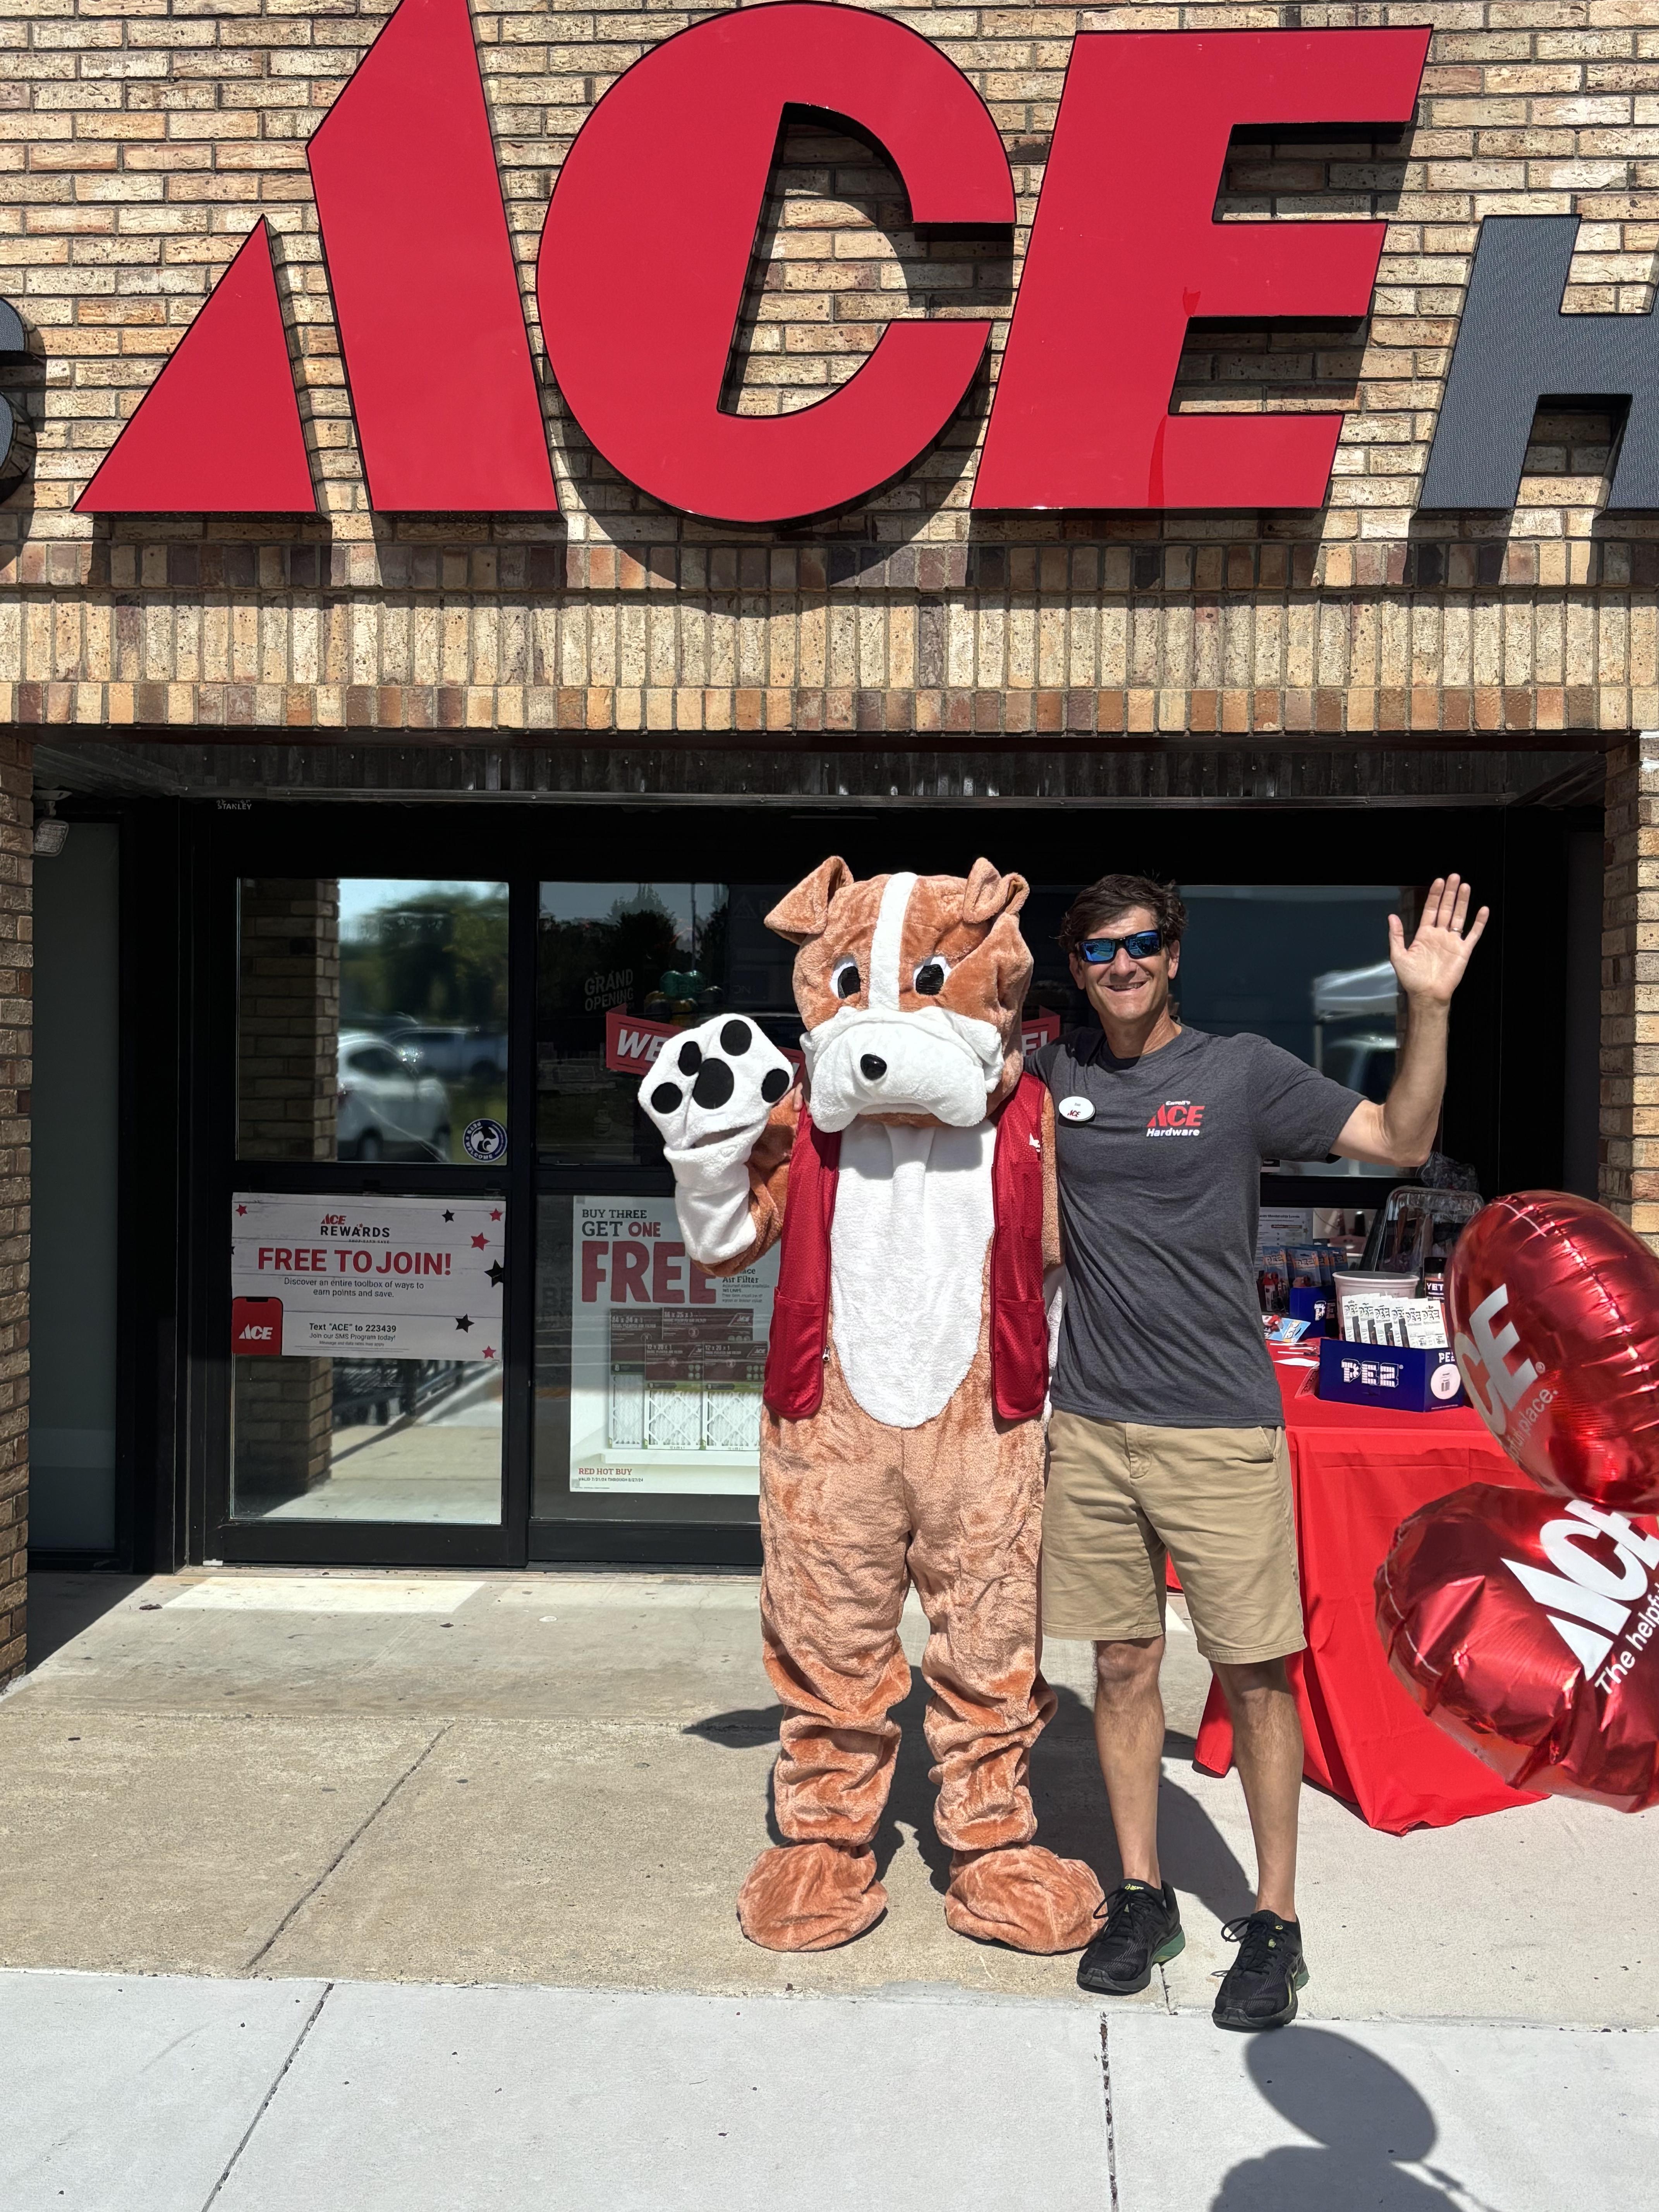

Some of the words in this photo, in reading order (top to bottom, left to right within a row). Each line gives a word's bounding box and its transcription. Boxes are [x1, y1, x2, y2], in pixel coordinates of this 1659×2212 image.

[72, 0, 1434, 524] ACE
[584, 969, 633, 995] GRAND
[585, 987, 634, 1012] OPENING
[1147, 1104, 1205, 1127] ACE
[1146, 1128, 1200, 1137] Hardware
[466, 1141, 493, 1159] WELCOME
[321, 1213, 347, 1224] ACE
[582, 1209, 606, 1218] BUY
[609, 1209, 647, 1218] THREE
[321, 1226, 390, 1237] REWARDS
[582, 1221, 623, 1237] GET
[628, 1222, 661, 1237] ONE
[258, 1247, 327, 1271] FREE
[334, 1250, 372, 1273] TO
[376, 1251, 452, 1276] JOIN!
[582, 1240, 716, 1304] FREE
[284, 1278, 317, 1286] Discover
[331, 1279, 352, 1287] entire
[354, 1279, 383, 1288] toolbox
[395, 1282, 414, 1290] ways
[333, 1289, 356, 1297] points
[358, 1289, 373, 1297] and
[1427, 1283, 1444, 1291] YET
[239, 1324, 273, 1340] ACE
[1341, 1358, 1399, 1388] PEZ
[1518, 1389, 1558, 1437] place.
[1500, 1499, 1659, 1681] ACE
[1595, 1650, 1635, 1695] The
[1625, 1582, 1659, 1651] helpf
